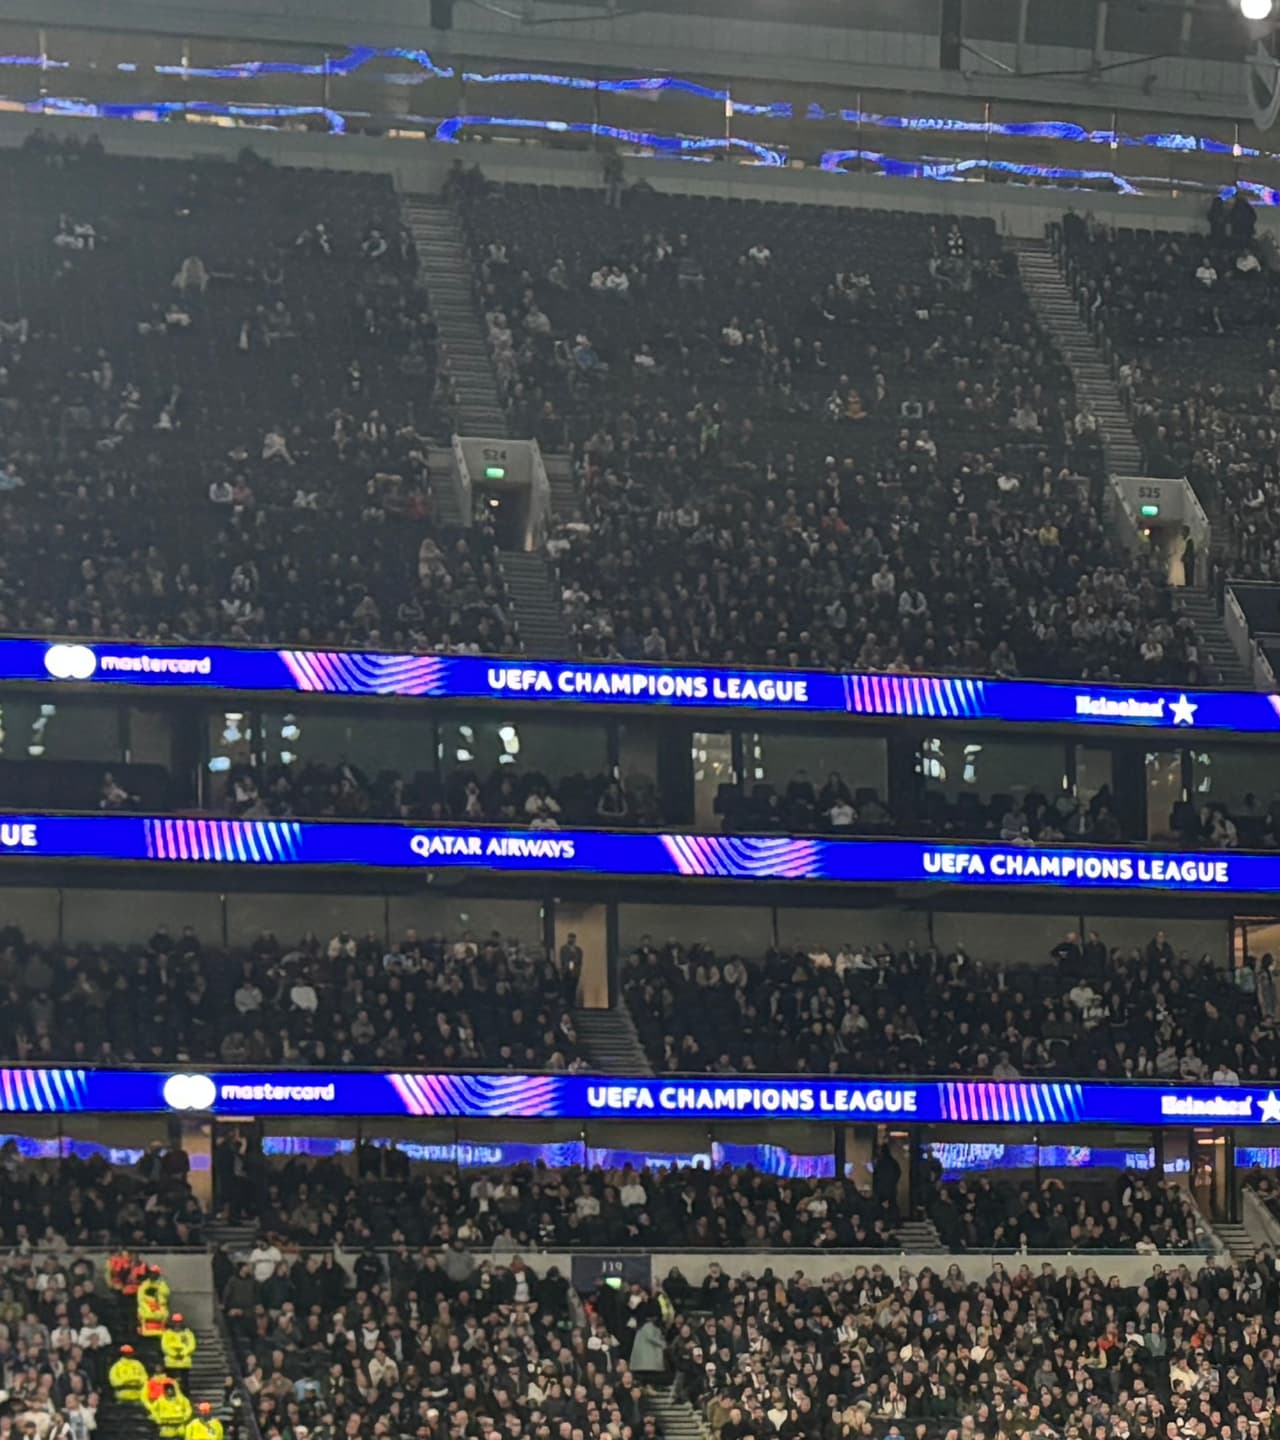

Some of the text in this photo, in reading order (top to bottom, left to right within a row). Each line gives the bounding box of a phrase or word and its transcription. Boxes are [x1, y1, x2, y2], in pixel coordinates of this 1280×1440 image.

[101, 656, 211, 675] mastercard
[488, 669, 808, 701] UEFA CHAMPIONS LEAGUE
[410, 835, 575, 858] QATAR AIRWAYS
[923, 853, 1228, 882] UEFA CHAMPIONS LEAGUE
[221, 1083, 334, 1100] mastercard
[588, 1087, 917, 1112] UEFA CHAMPIONS LEAGUE
